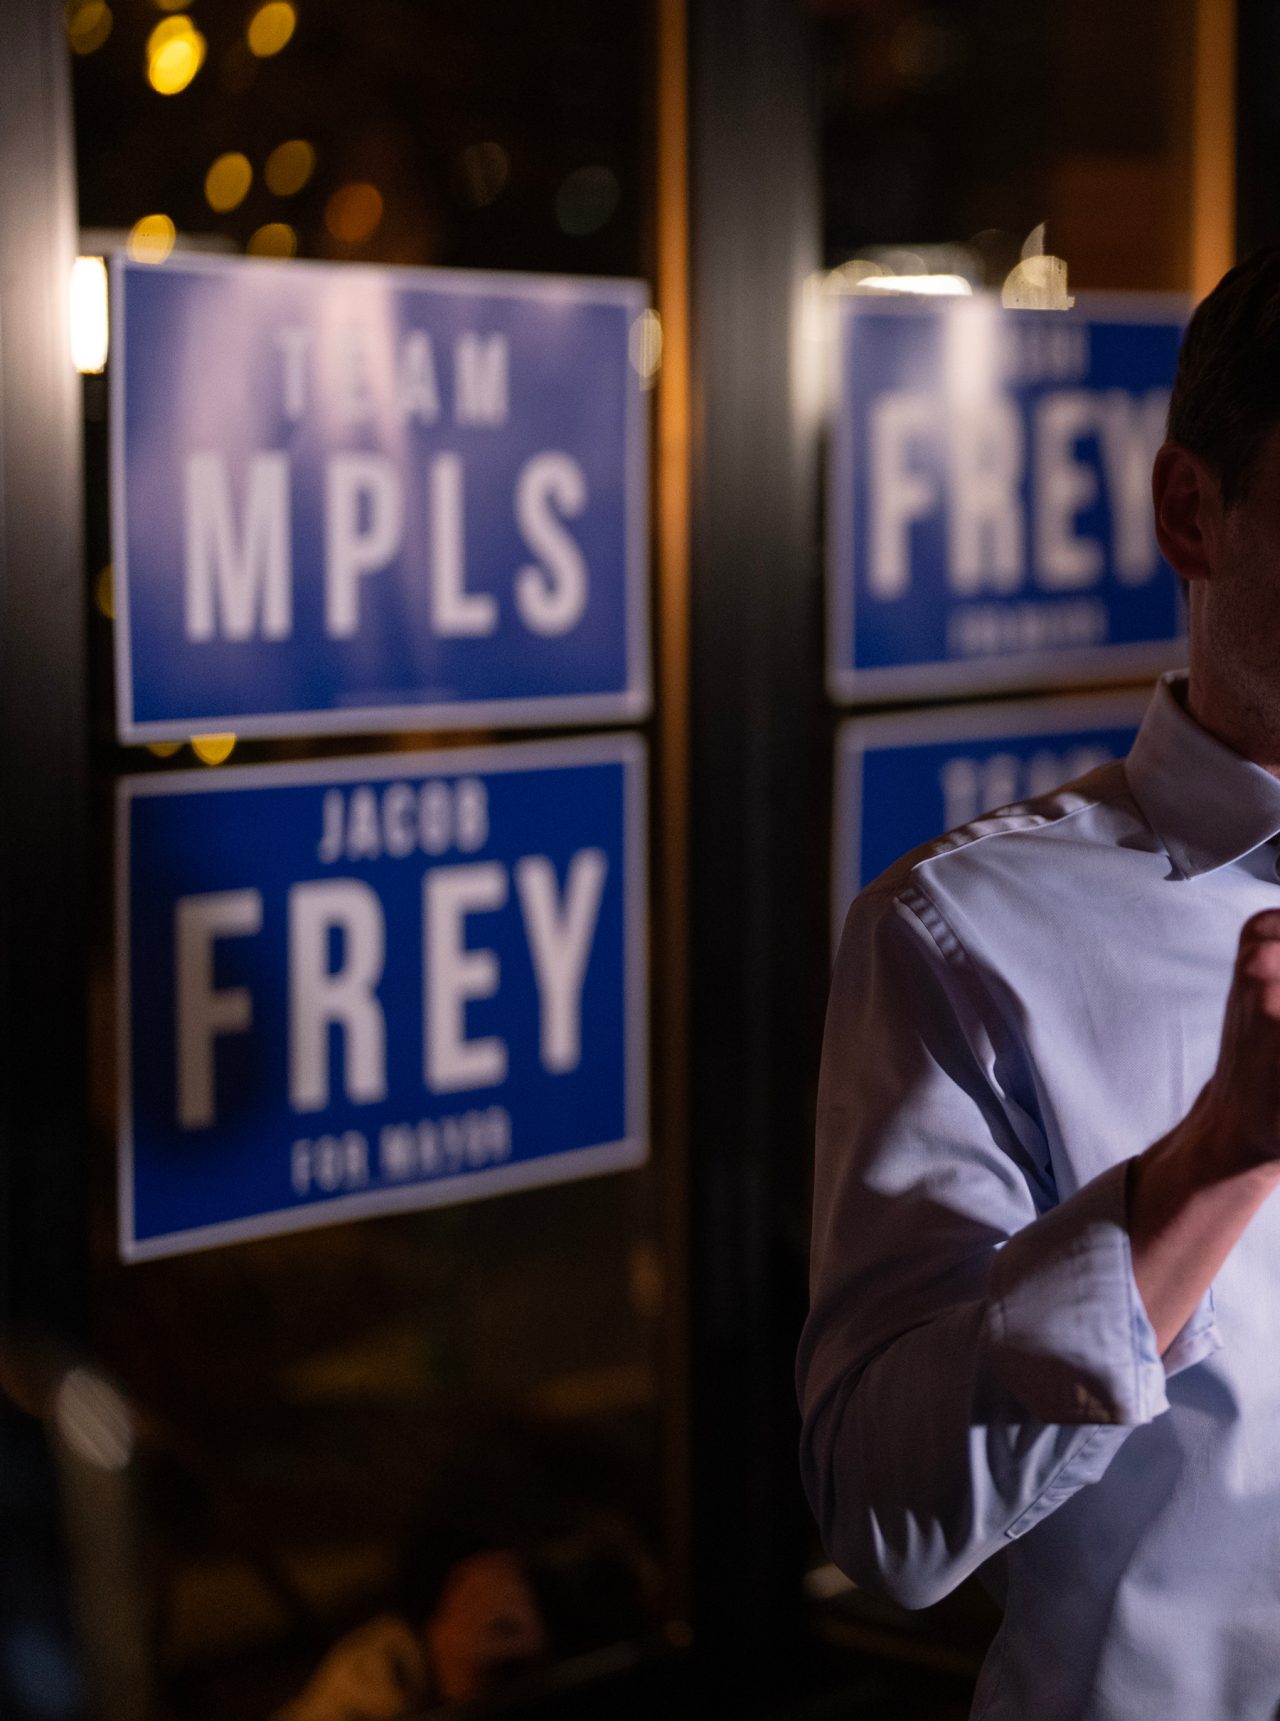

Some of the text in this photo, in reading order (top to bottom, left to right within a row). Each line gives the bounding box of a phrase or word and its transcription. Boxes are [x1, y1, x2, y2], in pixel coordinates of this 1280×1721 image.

[185, 450, 588, 642] MPLS
[870, 388, 1174, 598] FREY
[318, 777, 489, 862] JACOB
[174, 846, 608, 1130] FREY
[292, 1130, 369, 1194] FOR
